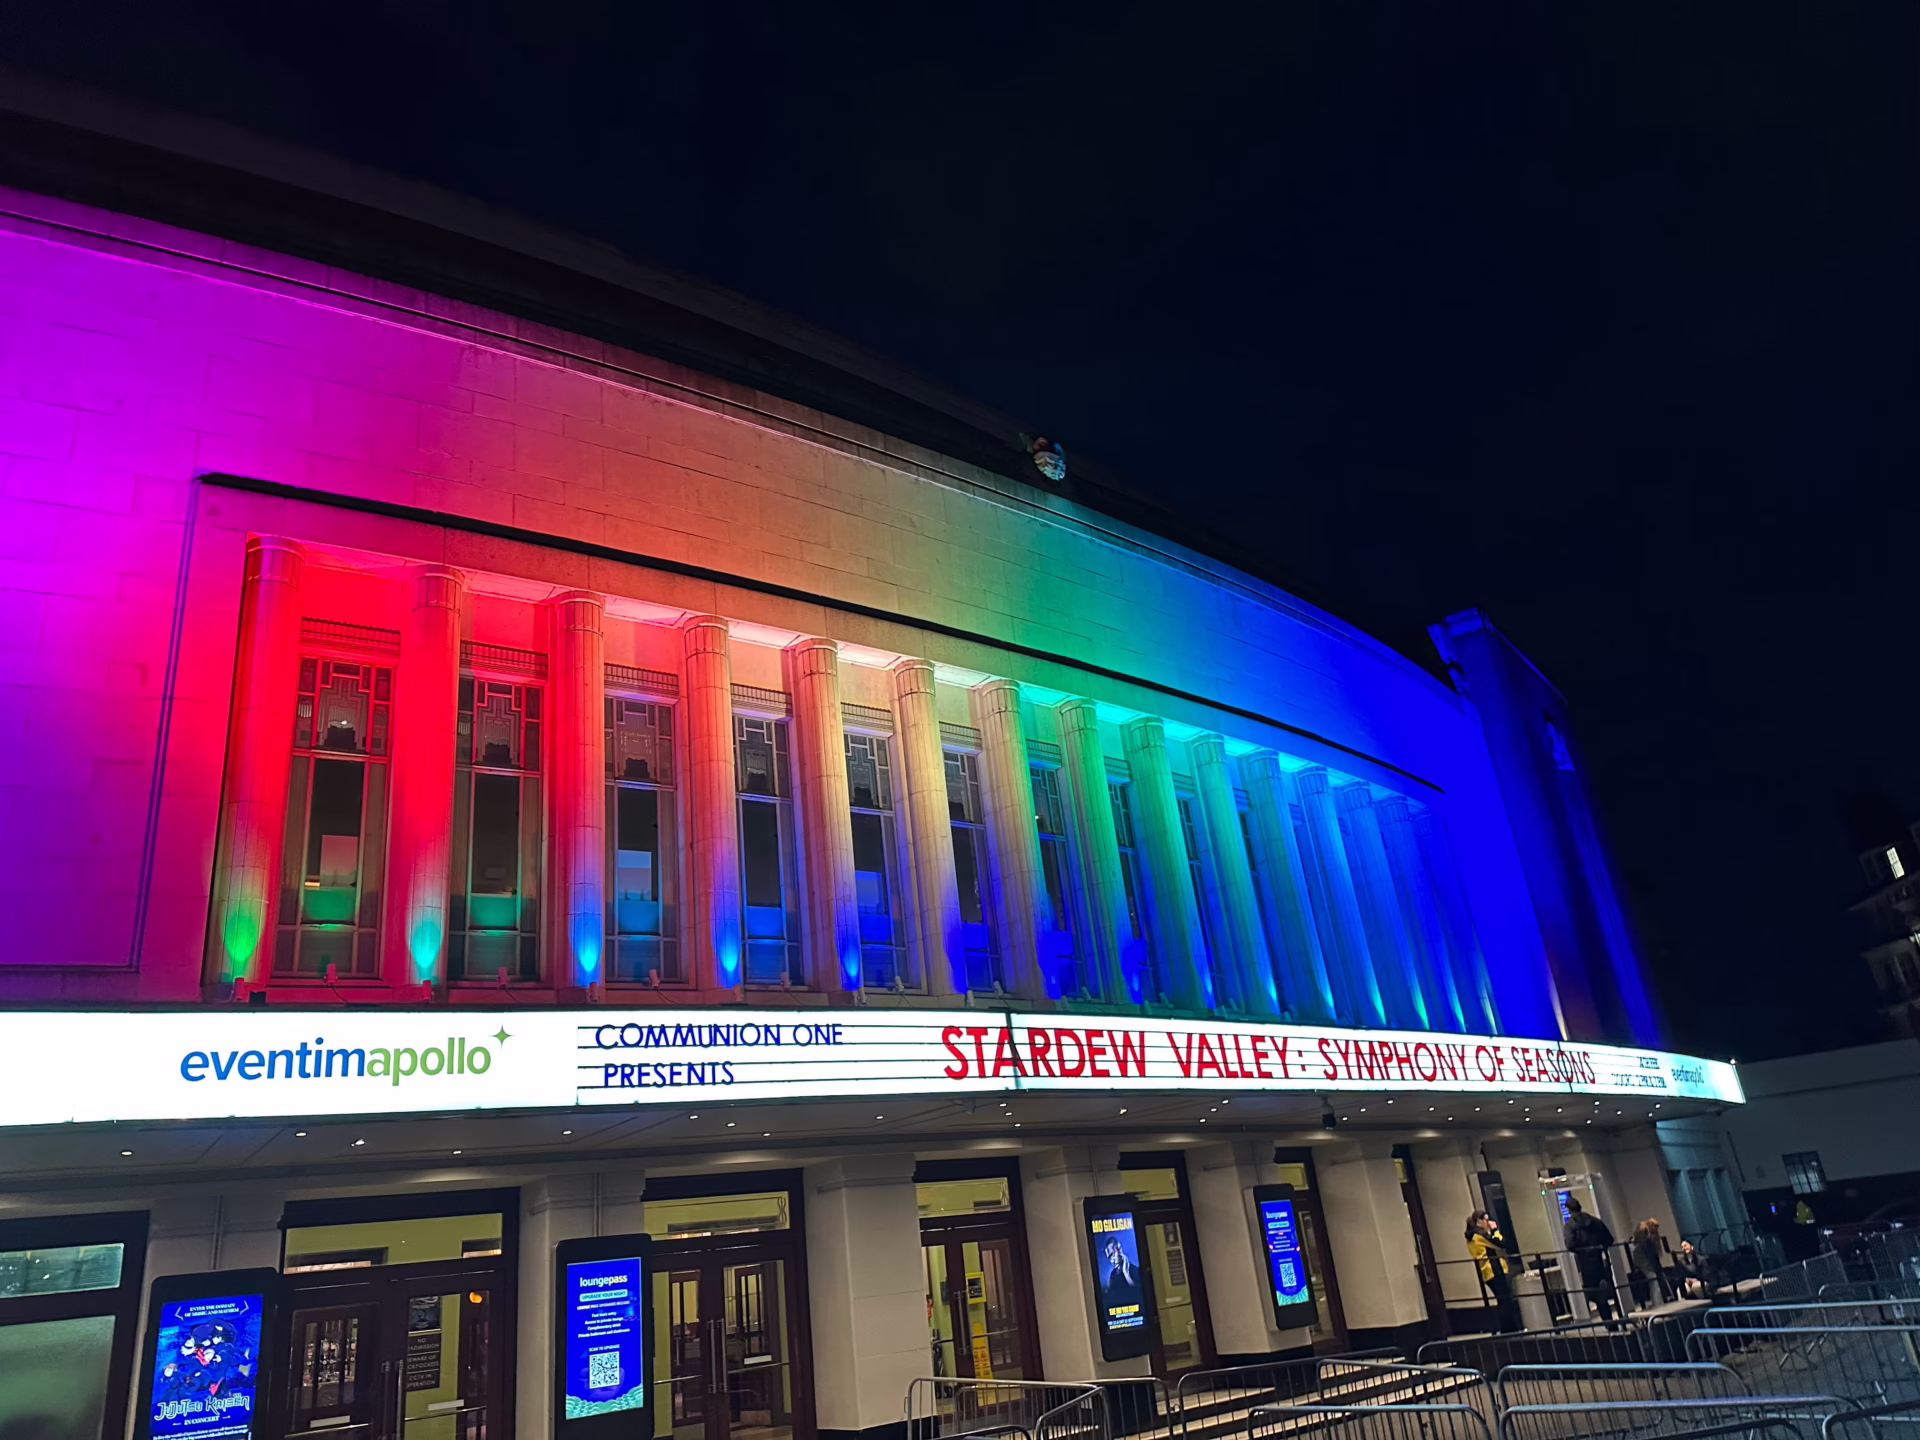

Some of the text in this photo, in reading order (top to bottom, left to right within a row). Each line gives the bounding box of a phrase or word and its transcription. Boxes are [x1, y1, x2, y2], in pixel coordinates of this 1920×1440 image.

[595, 1023, 843, 1049] COMMUNION ONE
[180, 1037, 491, 1087] eventimapollo
[942, 1025, 1596, 1084] STARDEW VALLEY: SYMPHONY OF SEASONS
[604, 1061, 734, 1088] PRESENTS
[1103, 1218, 1132, 1232] GILLIGAN
[580, 1274, 628, 1288] loungepass
[191, 1416, 220, 1424] CONCERT
